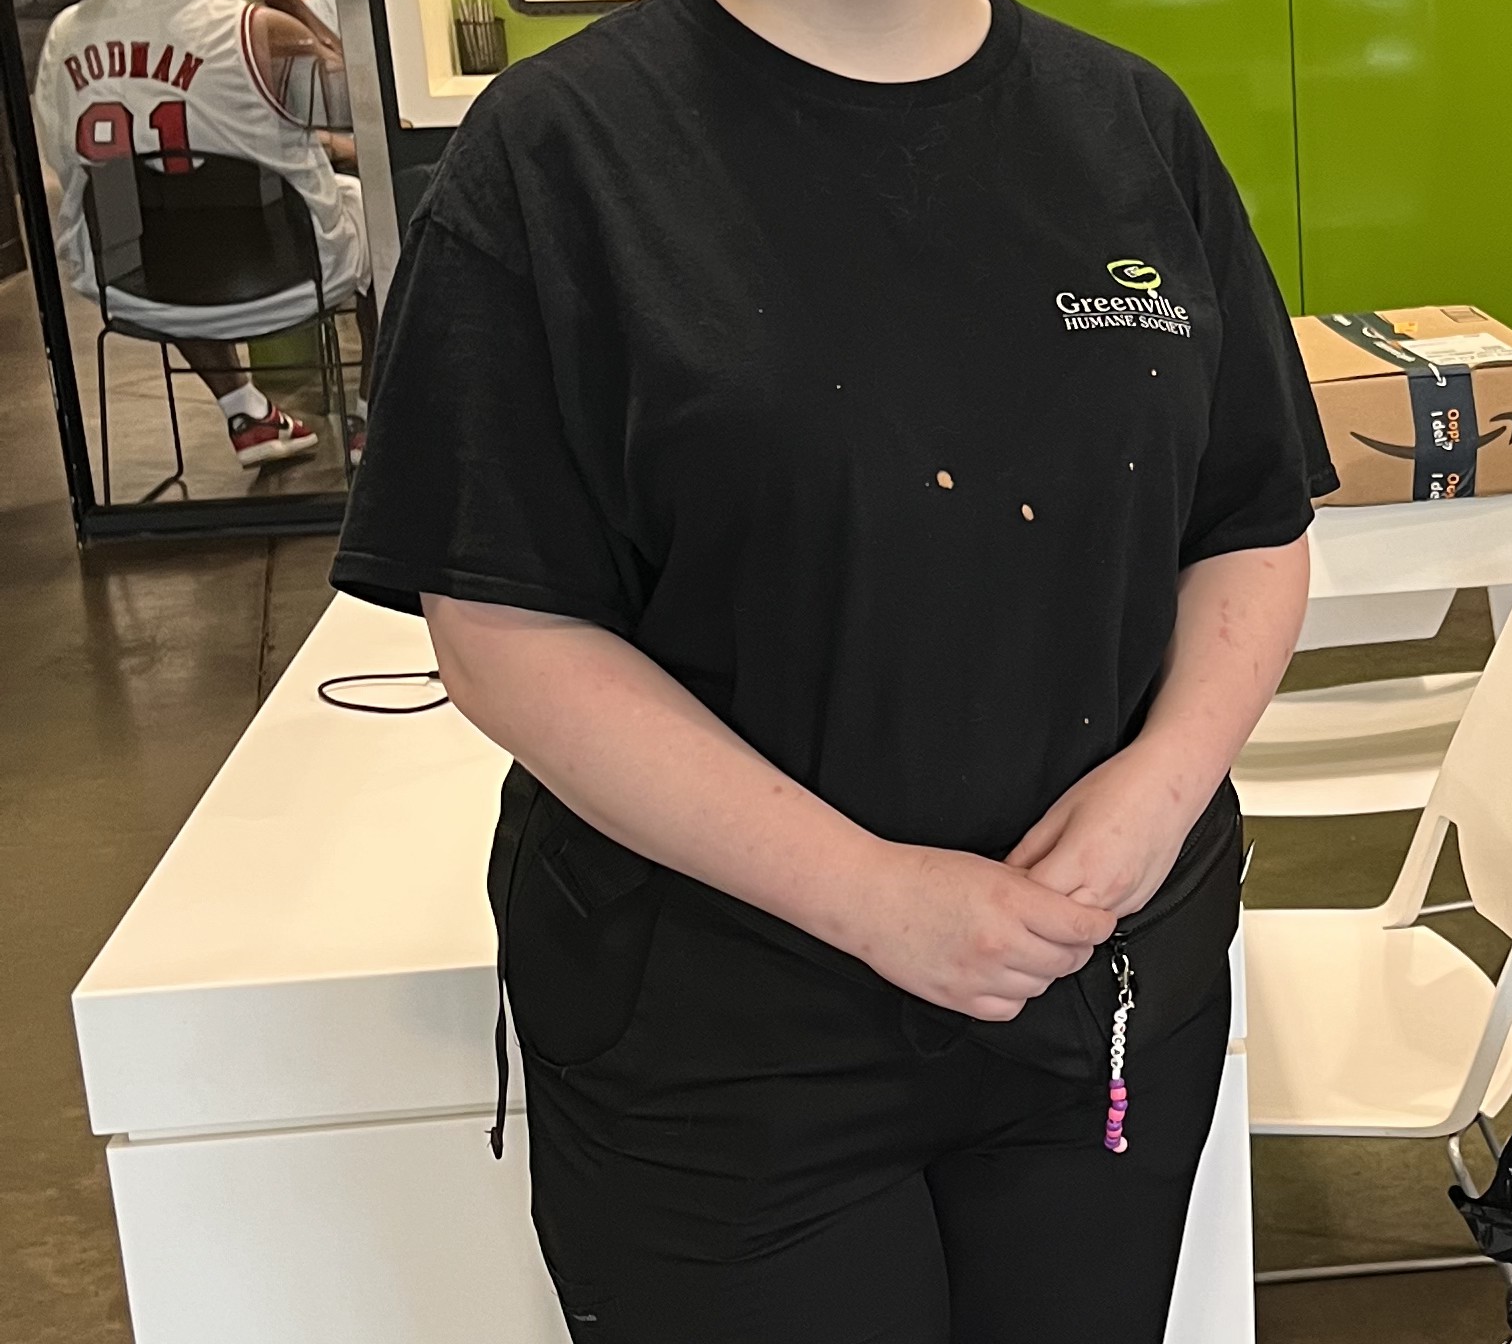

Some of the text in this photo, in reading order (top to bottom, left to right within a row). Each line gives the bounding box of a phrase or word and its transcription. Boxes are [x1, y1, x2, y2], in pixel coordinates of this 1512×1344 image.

[64, 40, 204, 92] RODMAN
[76, 100, 193, 174] 91
[1056, 292, 1189, 320] Greenville
[1064, 314, 1192, 338] HUMANE SOCIETY
